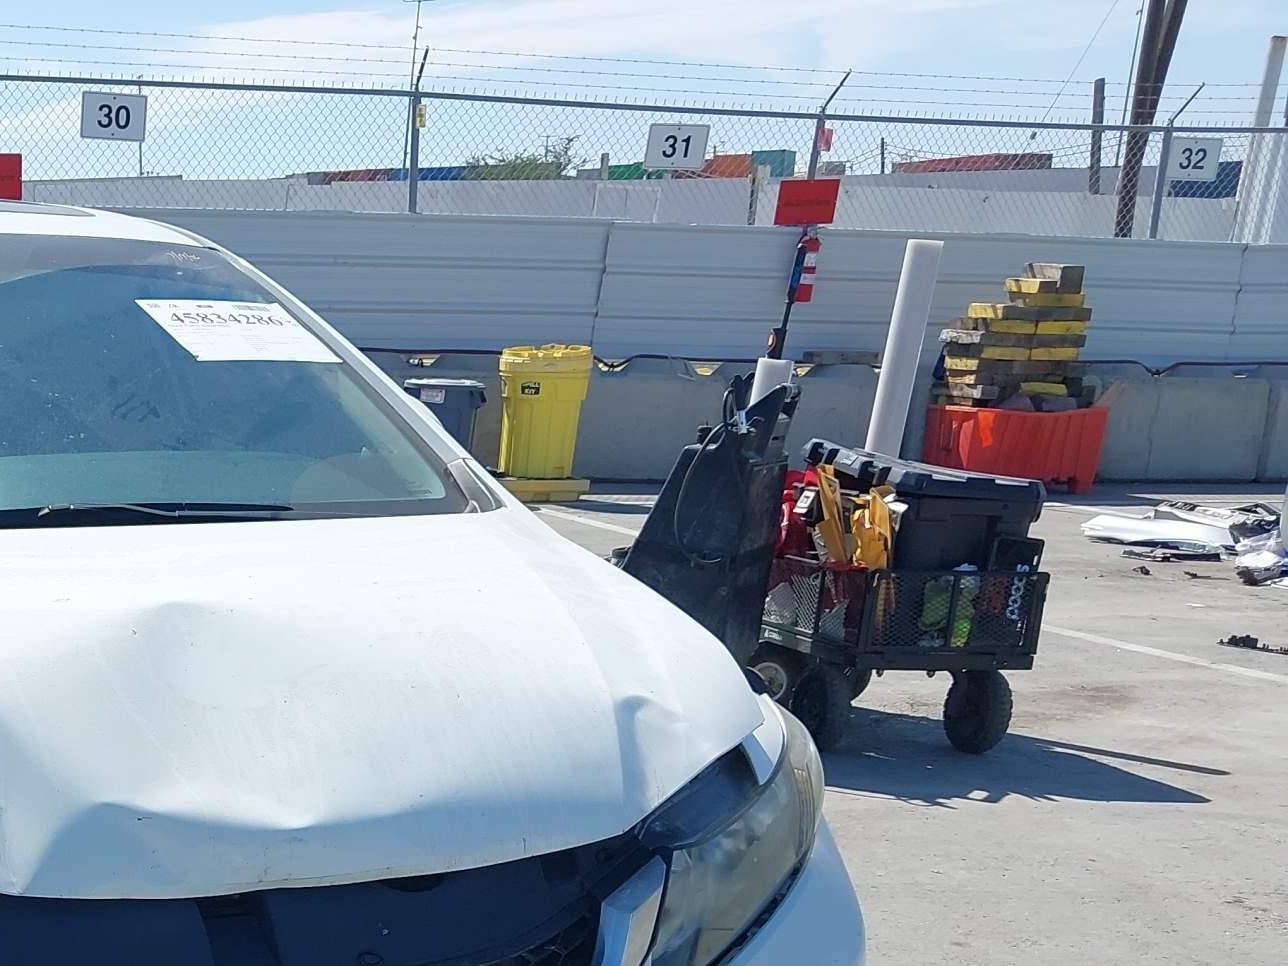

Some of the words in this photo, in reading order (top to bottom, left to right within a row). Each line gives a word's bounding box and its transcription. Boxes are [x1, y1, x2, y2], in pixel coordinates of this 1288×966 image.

[97, 103, 131, 130] 30
[662, 134, 691, 158] 31
[1179, 147, 1207, 170] 32
[171, 312, 283, 327] 45834286
